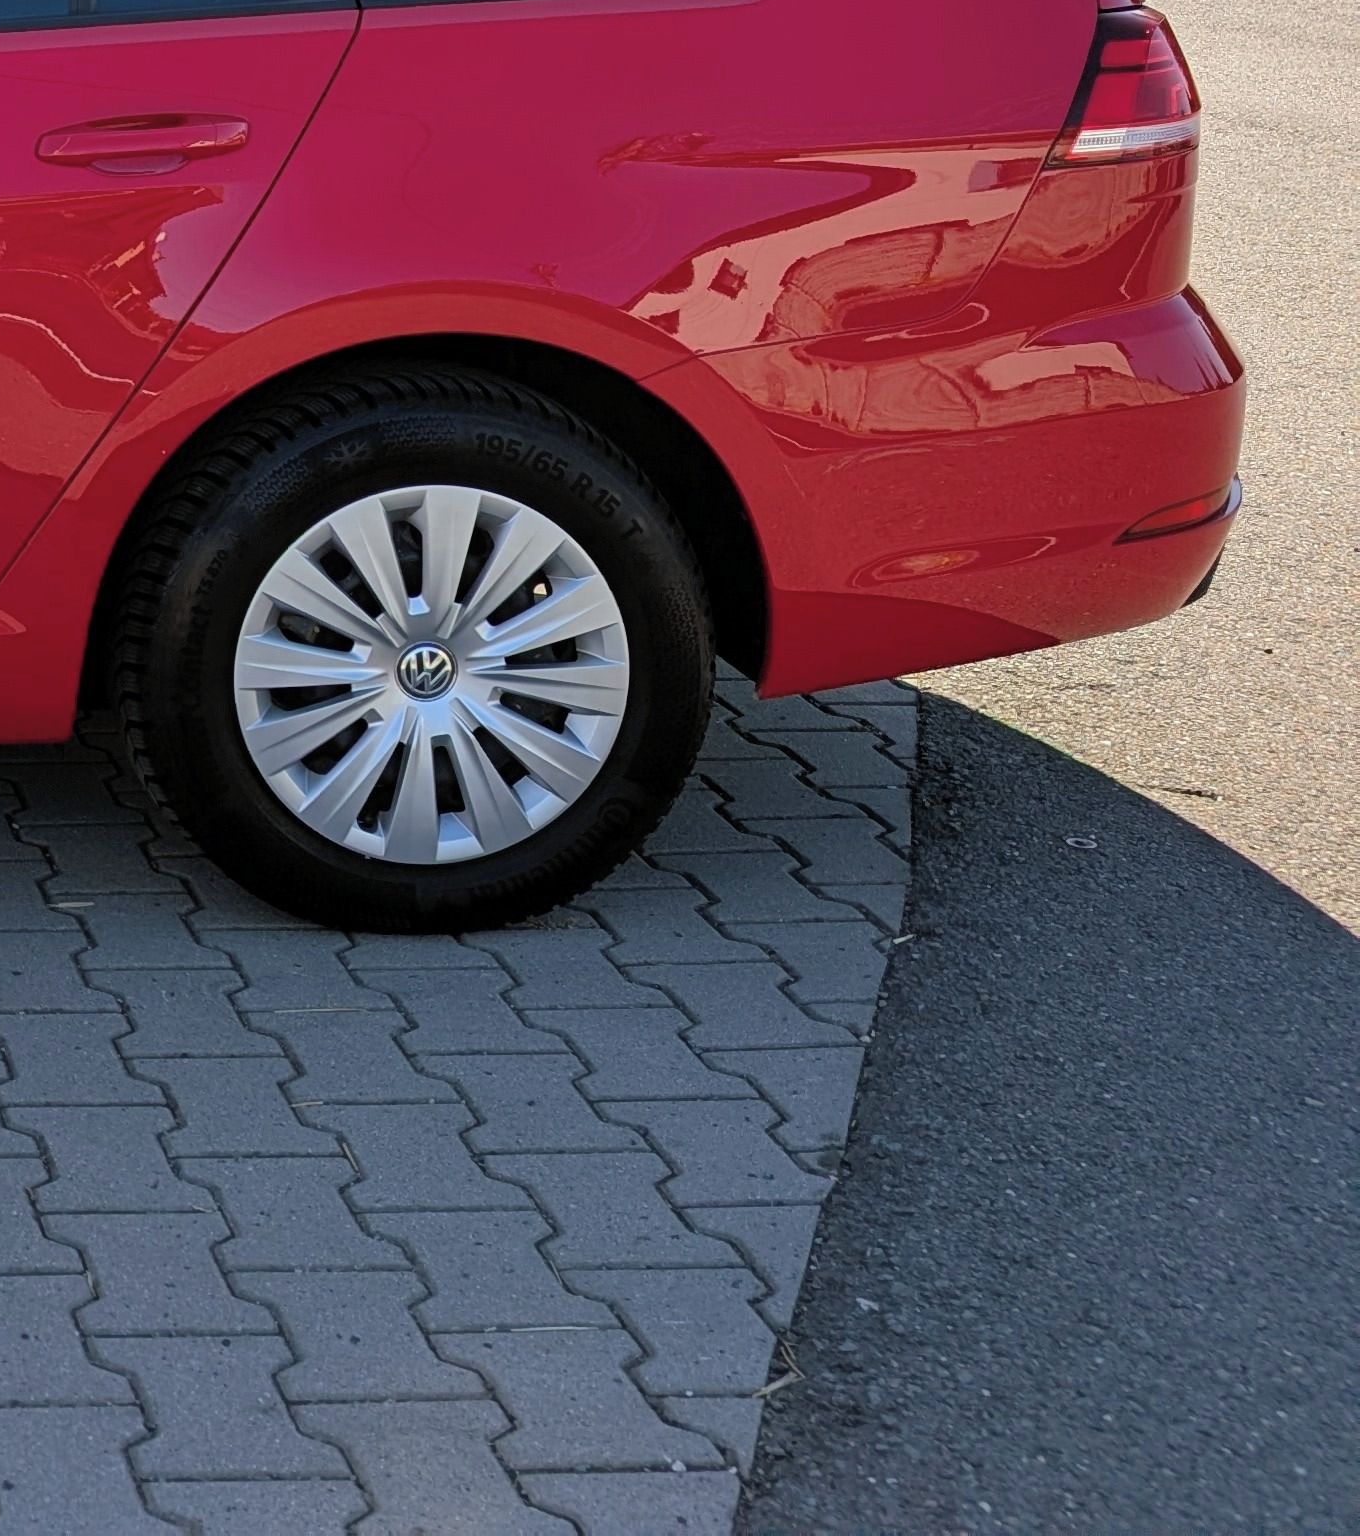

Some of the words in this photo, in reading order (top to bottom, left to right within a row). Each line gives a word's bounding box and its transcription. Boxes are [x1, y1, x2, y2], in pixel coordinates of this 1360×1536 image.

[475, 431, 568, 482] 195/65
[568, 469, 593, 495] R
[593, 488, 622, 519] 15
[621, 516, 644, 540] T
